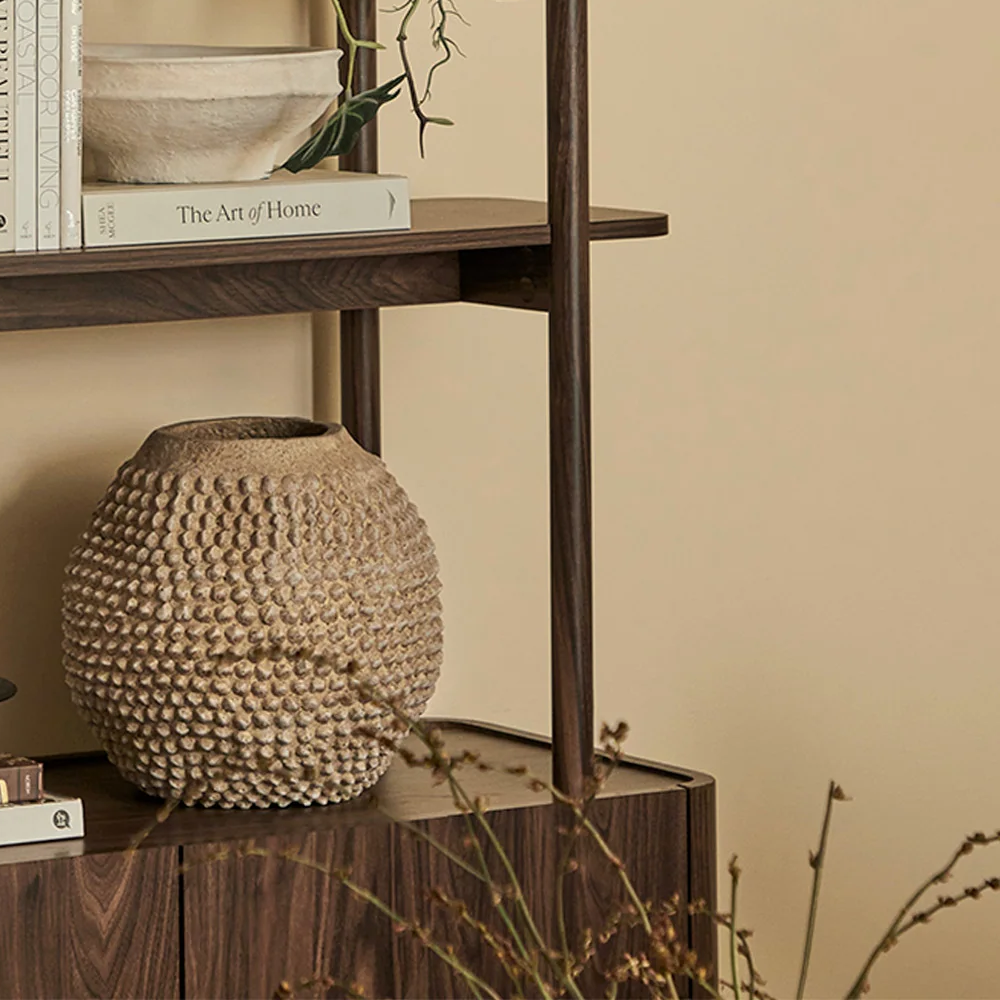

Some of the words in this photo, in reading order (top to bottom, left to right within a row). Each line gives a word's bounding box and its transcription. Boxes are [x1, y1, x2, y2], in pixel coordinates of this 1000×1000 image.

[40, 126, 59, 209] LIVING
[176, 205, 213, 225] The
[216, 204, 244, 222] Art
[248, 201, 265, 226] of
[266, 200, 321, 220] Home
